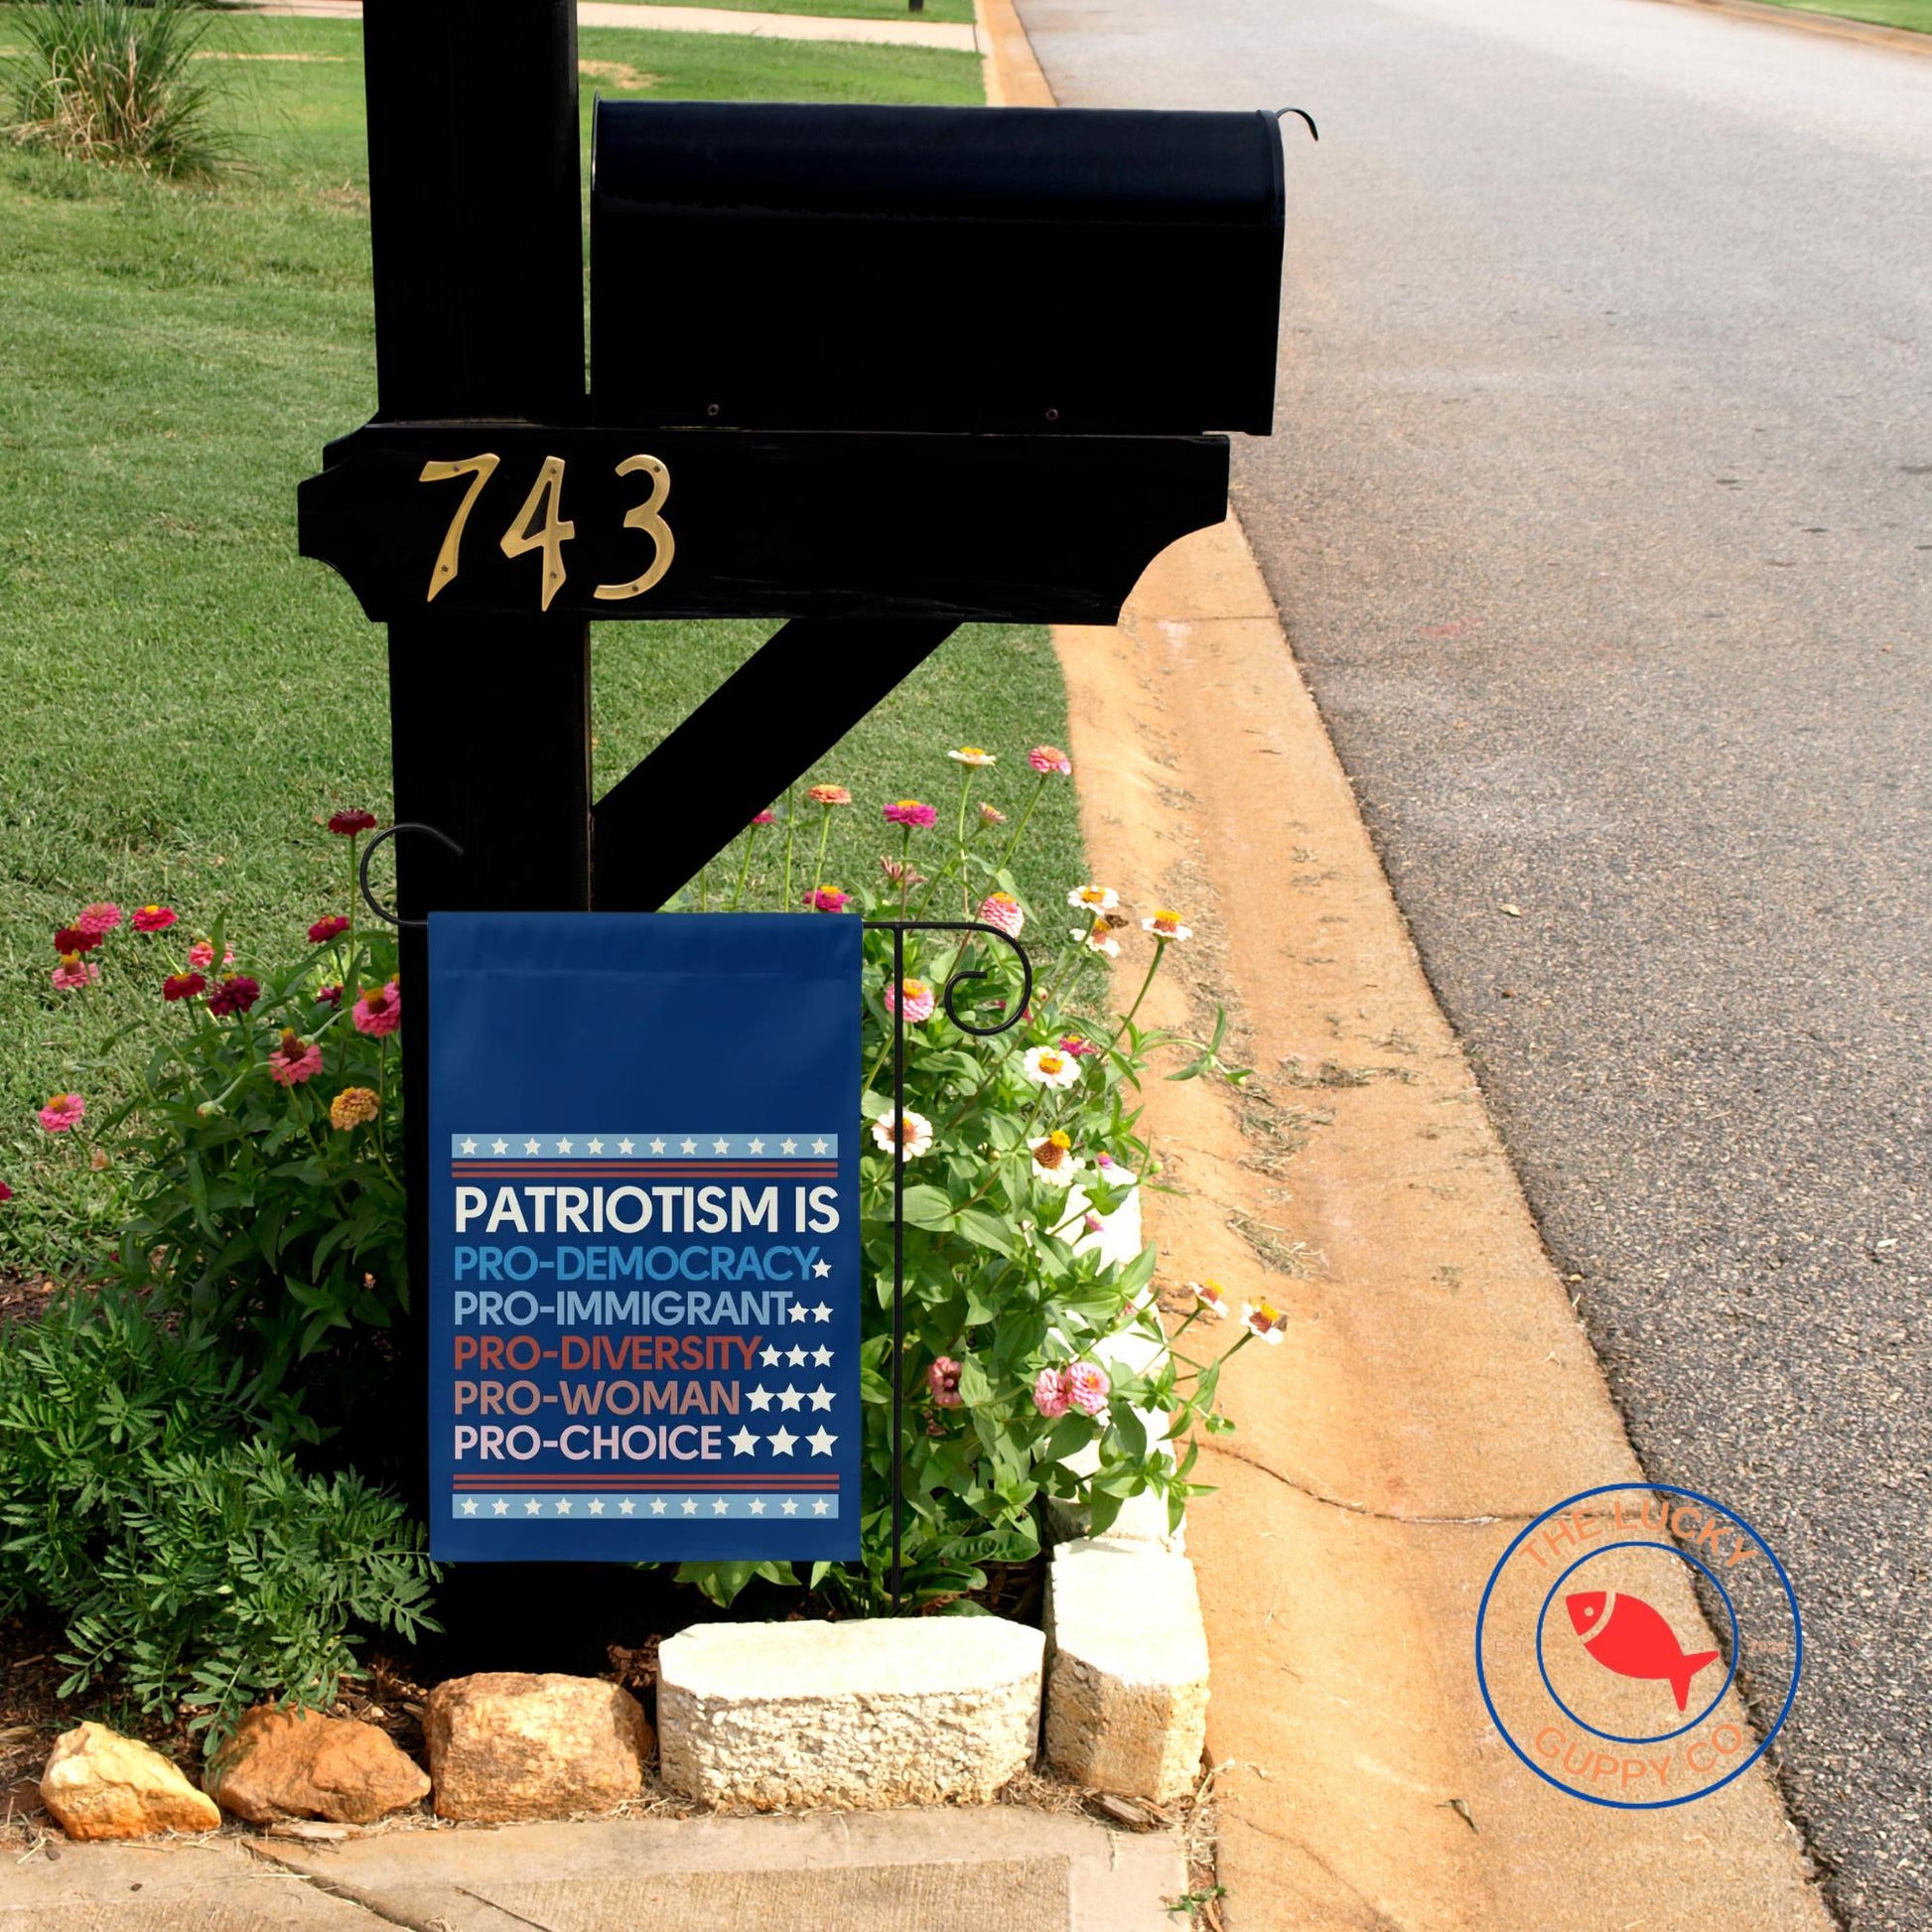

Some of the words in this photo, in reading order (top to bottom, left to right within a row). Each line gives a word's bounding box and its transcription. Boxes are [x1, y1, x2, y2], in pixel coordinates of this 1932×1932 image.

[419, 453, 675, 612] 743
[455, 1186, 778, 1233] PATRIOTISM
[795, 1186, 840, 1233] IS
[454, 1245, 820, 1282] PRO-DEMOCRACY
[454, 1290, 793, 1326] PRO-IMMIGRANT
[454, 1334, 762, 1371] PRO-DIVERSITY
[454, 1379, 740, 1416] PRO-WOMAN
[454, 1424, 722, 1460] PRO-CHOICE
